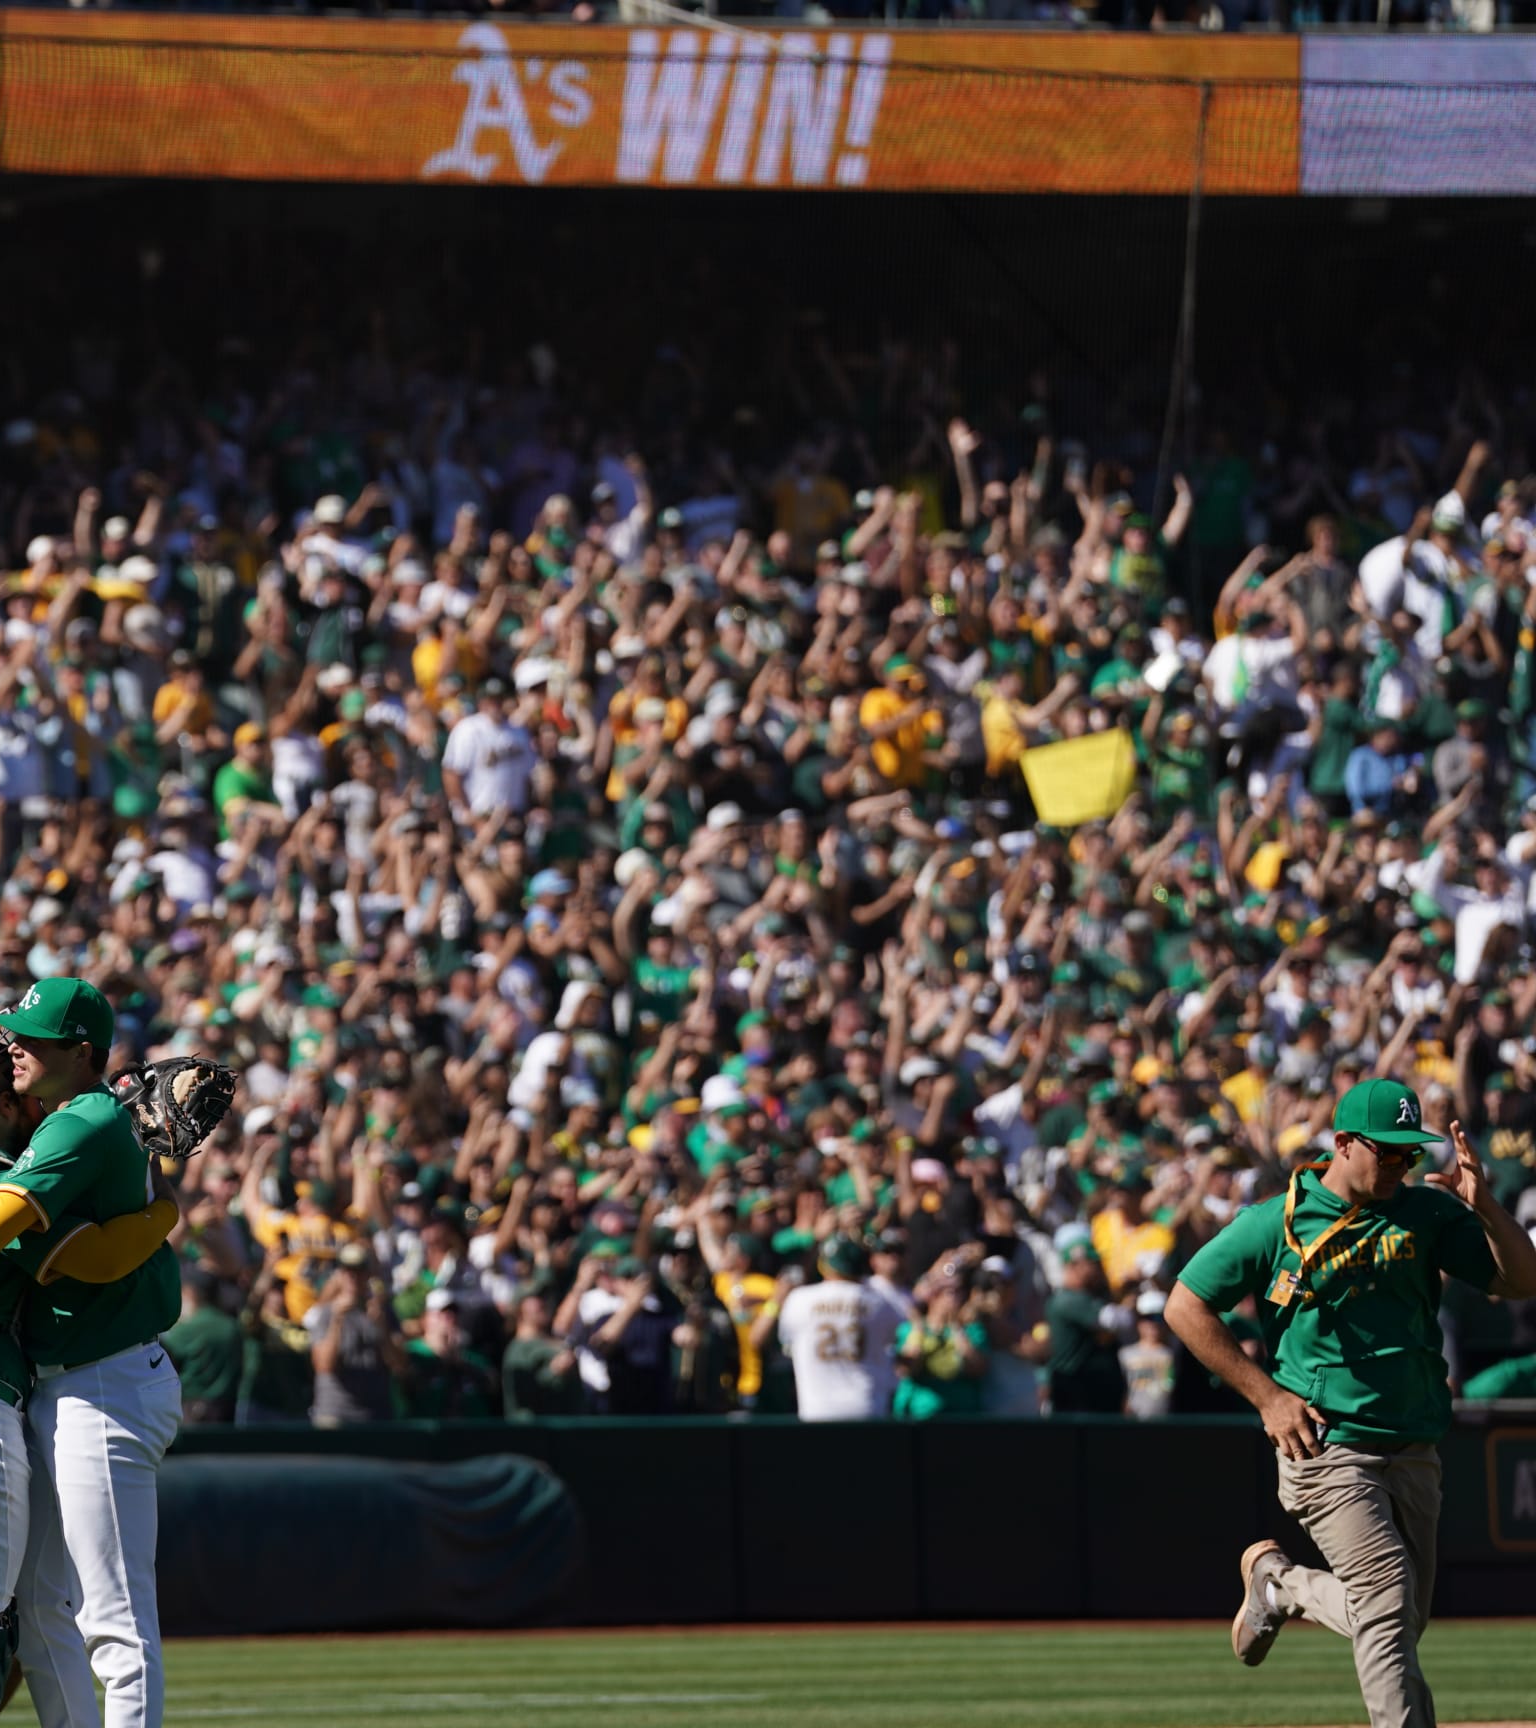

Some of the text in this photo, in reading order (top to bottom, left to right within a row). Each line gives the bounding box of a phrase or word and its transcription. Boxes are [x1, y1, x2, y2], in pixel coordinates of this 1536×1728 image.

[422, 23, 892, 187] A's WIN!
[18, 984, 41, 1011] A's
[1396, 1097, 1419, 1124] A's
